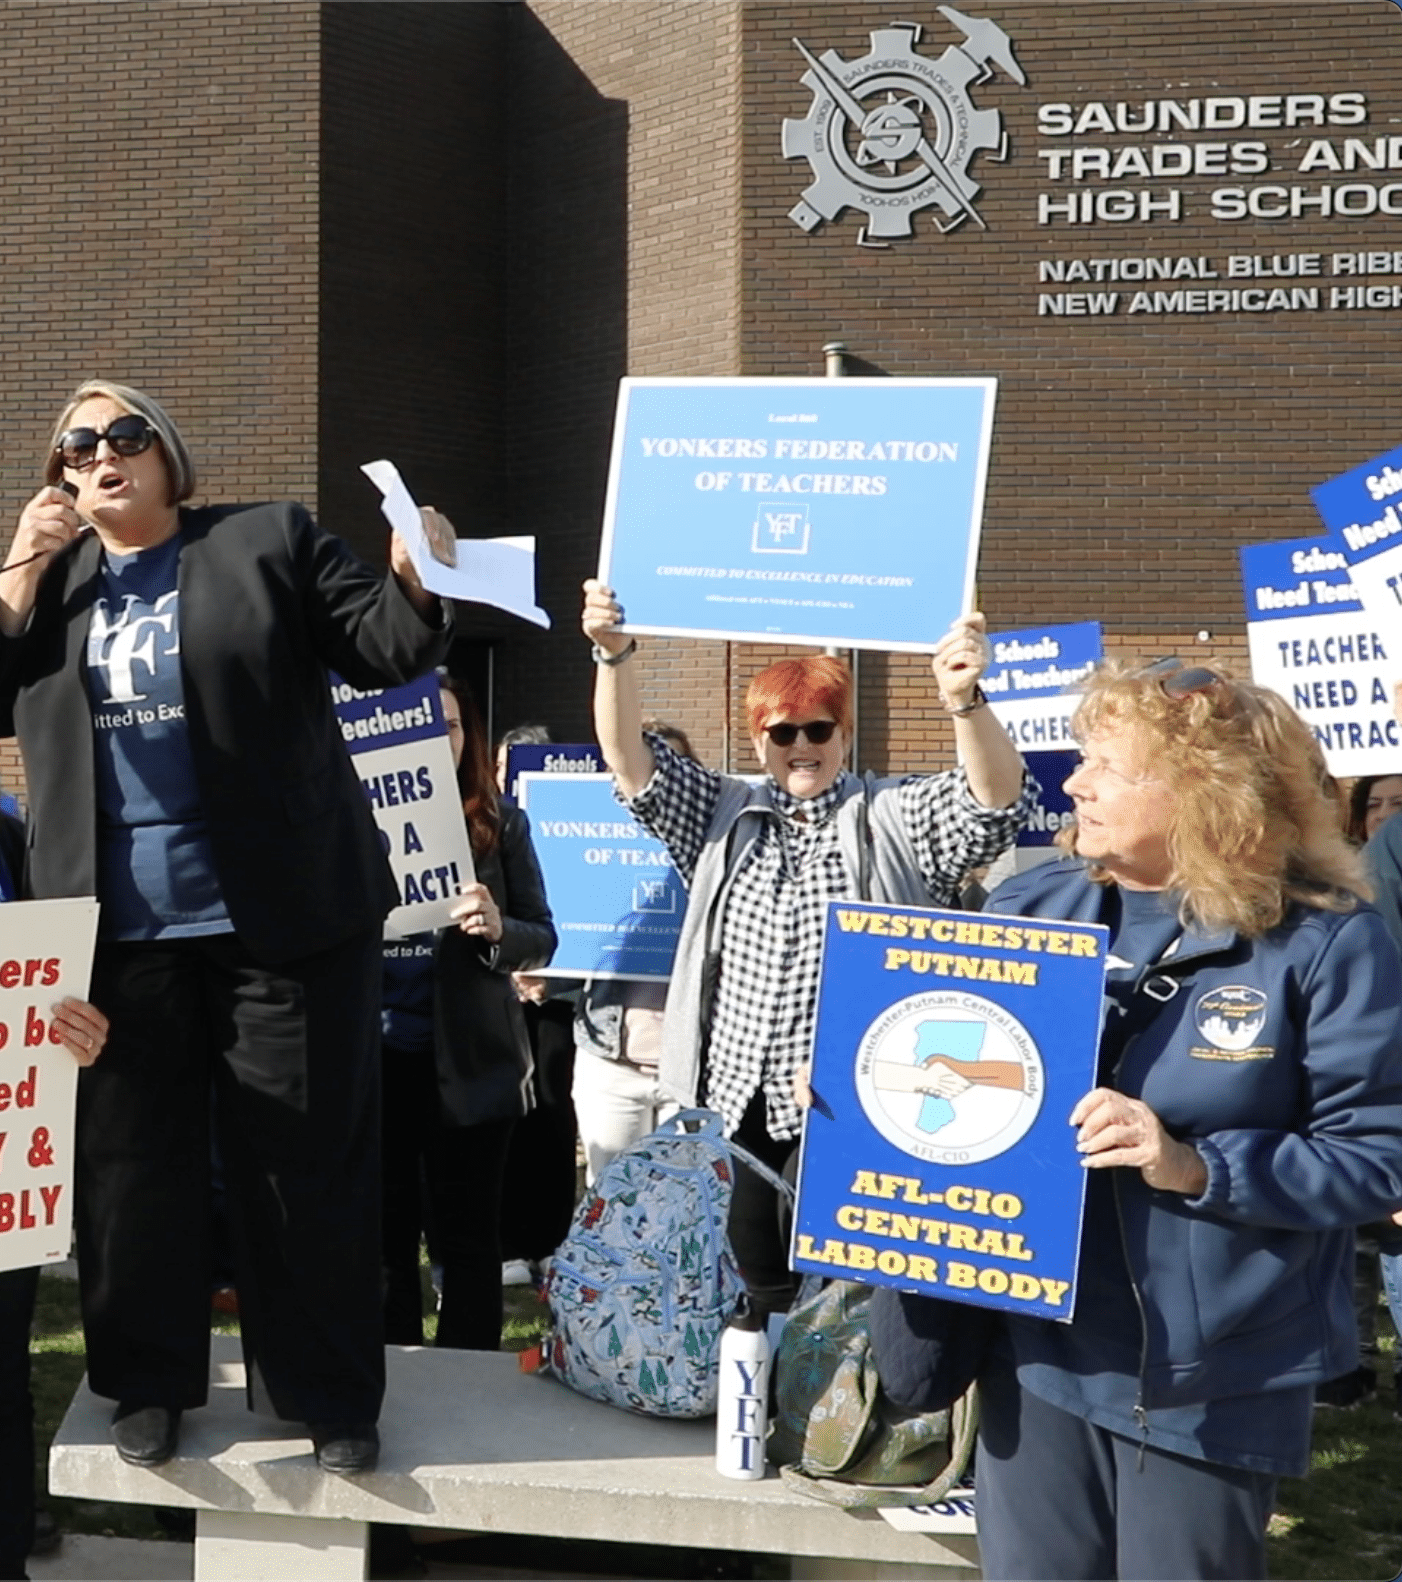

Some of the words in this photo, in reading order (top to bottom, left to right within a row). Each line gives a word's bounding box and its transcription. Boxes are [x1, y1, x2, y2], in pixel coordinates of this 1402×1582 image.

[843, 59, 909, 84] SAUNDERS
[912, 61, 953, 94] TRADES
[950, 100, 969, 167] TECHNICAL
[1038, 93, 1366, 135] SAUNDERS
[1038, 142, 1268, 180] TRADES
[858, 192, 909, 207] SCHOOL
[911, 182, 942, 204] HIGH
[1038, 189, 1180, 224] HIGH
[1039, 256, 1218, 282] NATIONAL
[1228, 253, 1321, 278] BLUE
[1038, 292, 1118, 316] NEW
[1128, 287, 1319, 314] AMERICAN
[640, 437, 768, 460] YONKERS
[775, 439, 959, 463] FEDERATION
[694, 471, 733, 492] OF
[737, 472, 888, 496] TEACHERS
[1342, 506, 1402, 551] Need
[728, 568, 745, 580] TO
[824, 572, 840, 584] IN
[1256, 581, 1309, 610] Need
[994, 636, 1059, 663] Schools
[1293, 680, 1358, 709] NEED
[1371, 677, 1388, 704] A
[136, 709, 155, 724] to
[339, 697, 434, 741] eachers!
[544, 754, 598, 772] Schools
[403, 822, 423, 855] A
[539, 821, 639, 839] YONKERS
[584, 849, 613, 865] OF
[402, 861, 462, 906] ACT!
[835, 910, 1099, 957] WESTCHESTER
[884, 948, 1038, 985] PUTNAM
[861, 996, 958, 1075] Westchester-Putnam
[962, 997, 1011, 1028] Central
[1008, 1022, 1034, 1062] Labor
[1026, 1065, 1039, 1099] Body
[27, 1126, 55, 1168] &
[910, 1144, 971, 1163] AFL-CIO
[851, 1170, 1024, 1220] AFL-CIO
[836, 1205, 1034, 1261] CENTRAL
[796, 1235, 938, 1283] LABOR
[946, 1261, 1070, 1306] BODY
